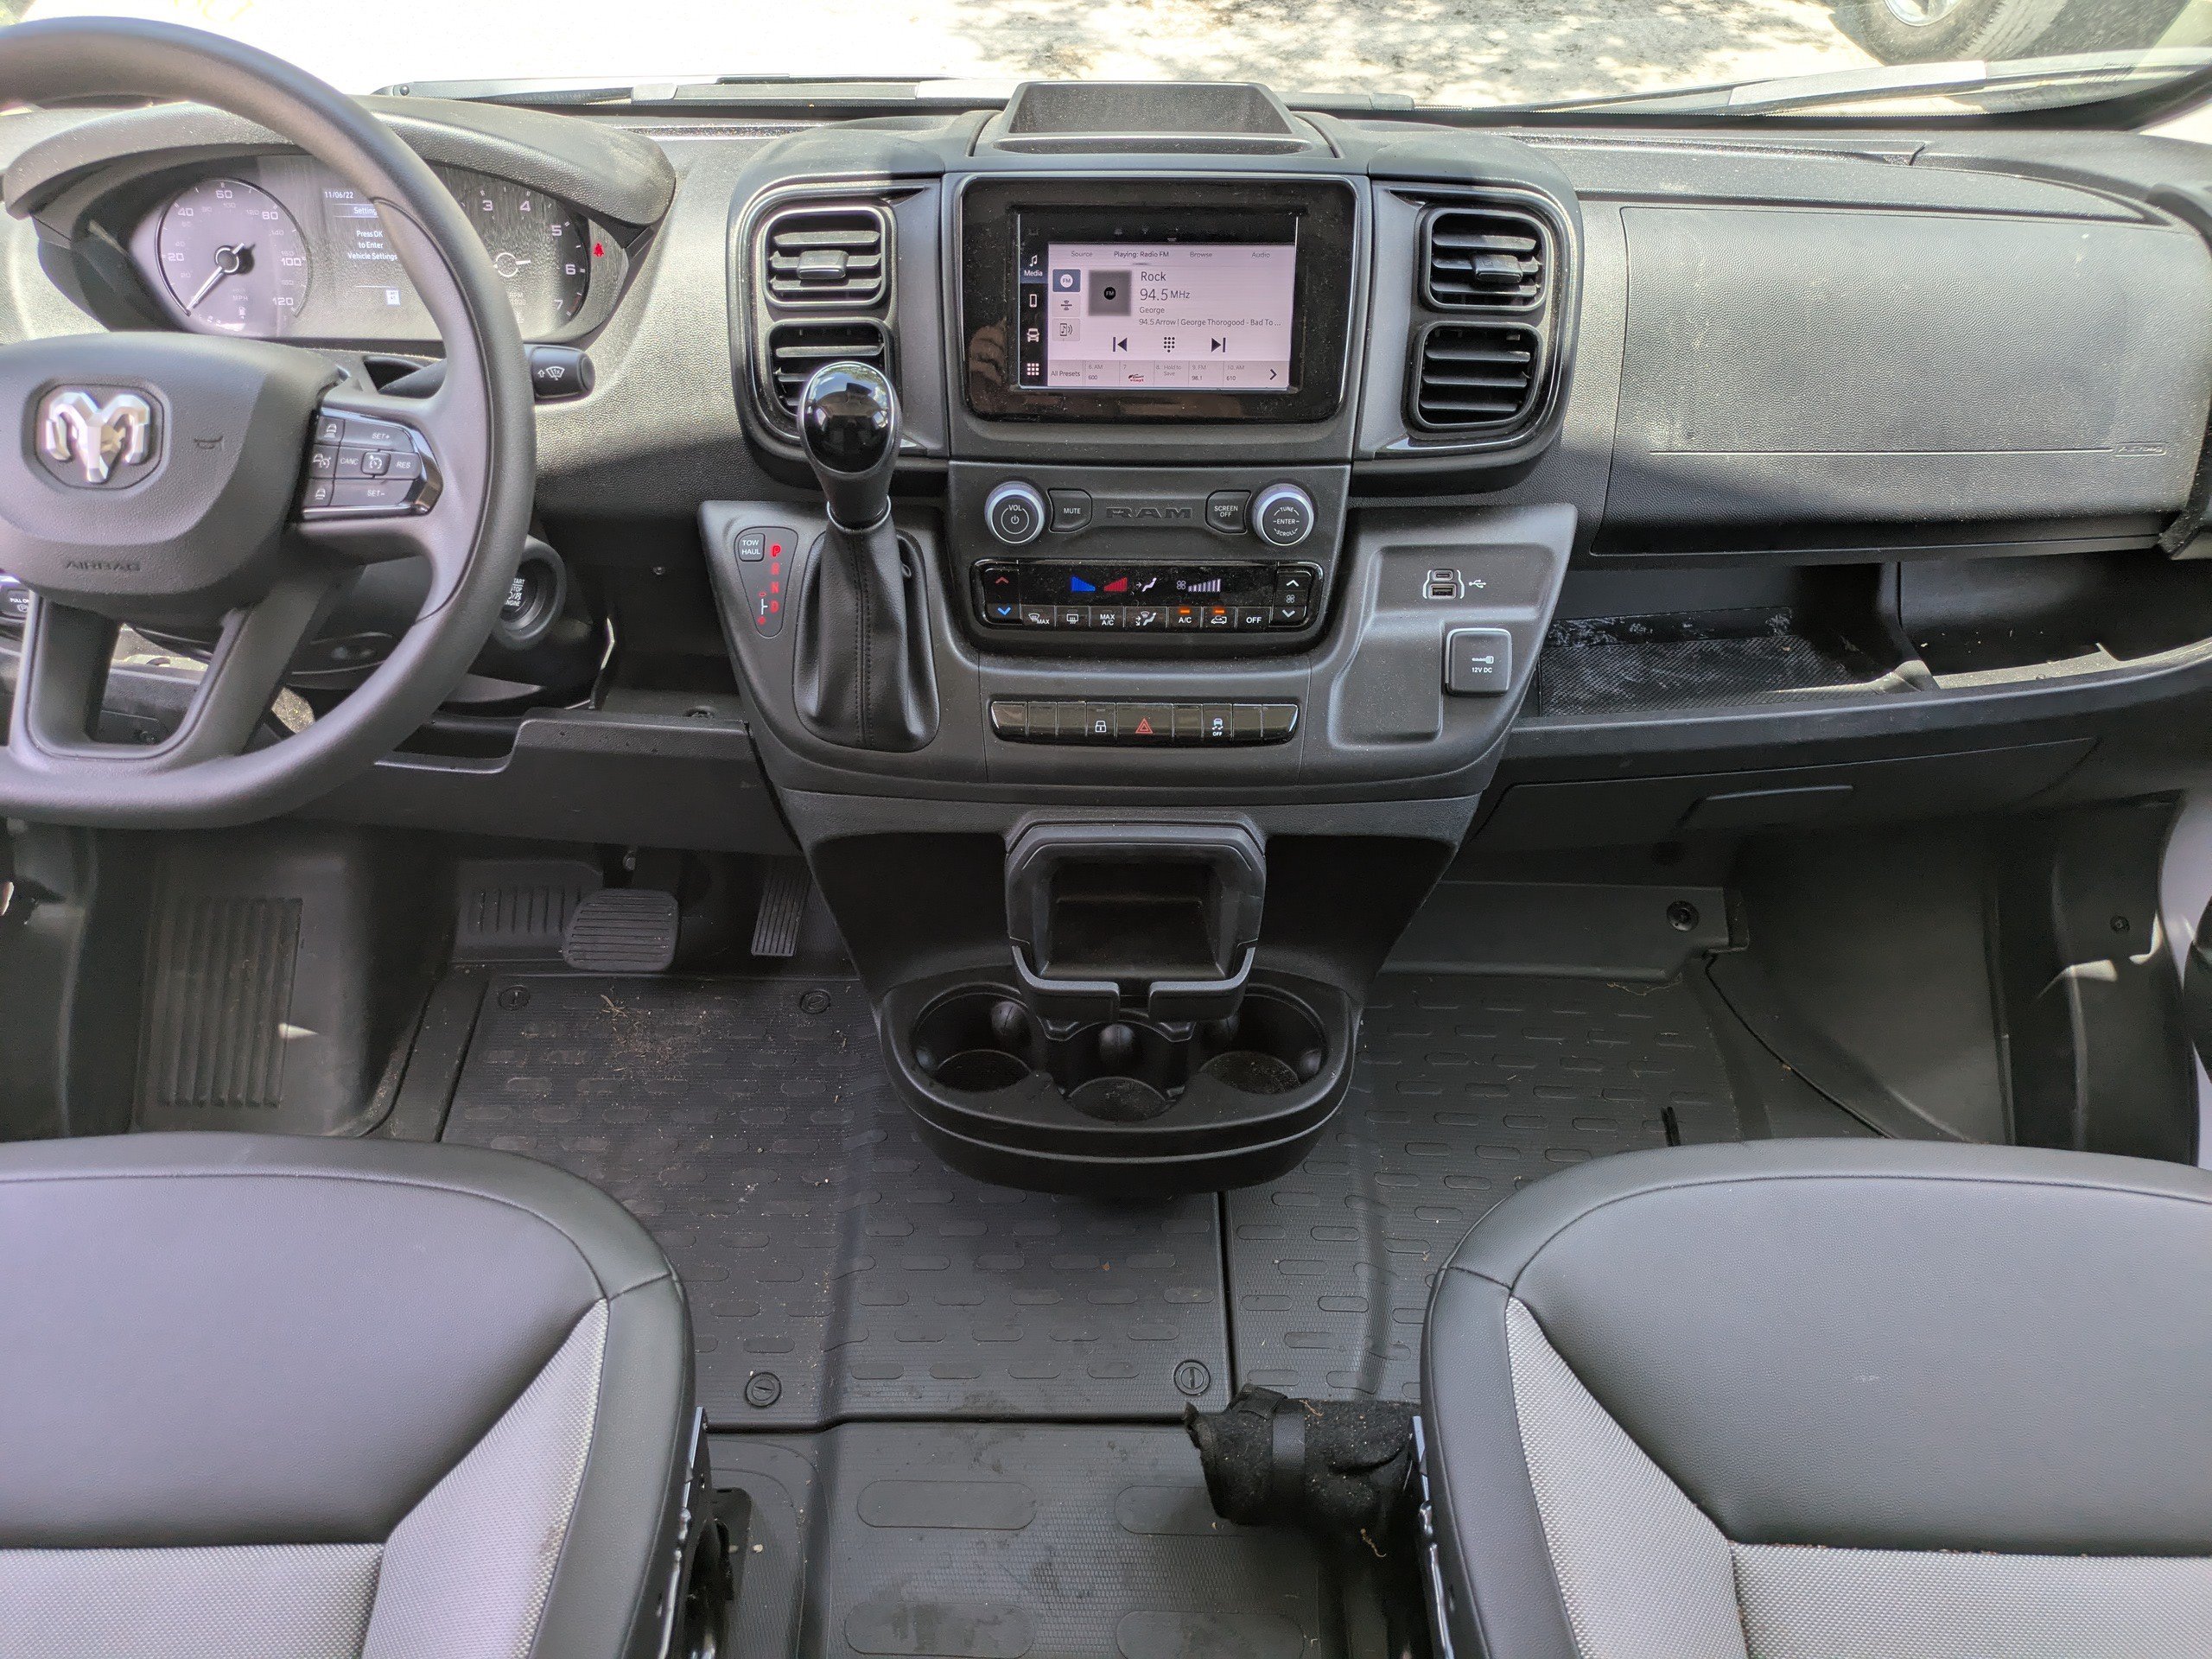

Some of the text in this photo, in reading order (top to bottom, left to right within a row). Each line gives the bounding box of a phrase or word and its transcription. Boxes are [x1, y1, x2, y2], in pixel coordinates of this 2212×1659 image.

[483, 200, 493, 211] 3
[520, 200, 531, 212] 4
[178, 208, 194, 216] 40
[262, 212, 278, 220] 80
[354, 207, 377, 216] Setting
[552, 225, 562, 236] 5
[281, 258, 302, 266] 100
[372, 253, 398, 261] Settings
[566, 264, 576, 275] 6
[1141, 271, 1166, 281] Rock
[1140, 288, 1168, 301] 94.5
[272, 297, 294, 306] 120
[554, 299, 563, 309] 7
[1139, 307, 1165, 315] George
[1181, 319, 1206, 327] George
[1208, 318, 1245, 327] Thorogood
[1106, 507, 1192, 518] RAM
[772, 545, 781, 557] P
[67, 562, 141, 571] AIRBAG
[771, 581, 779, 593] N
